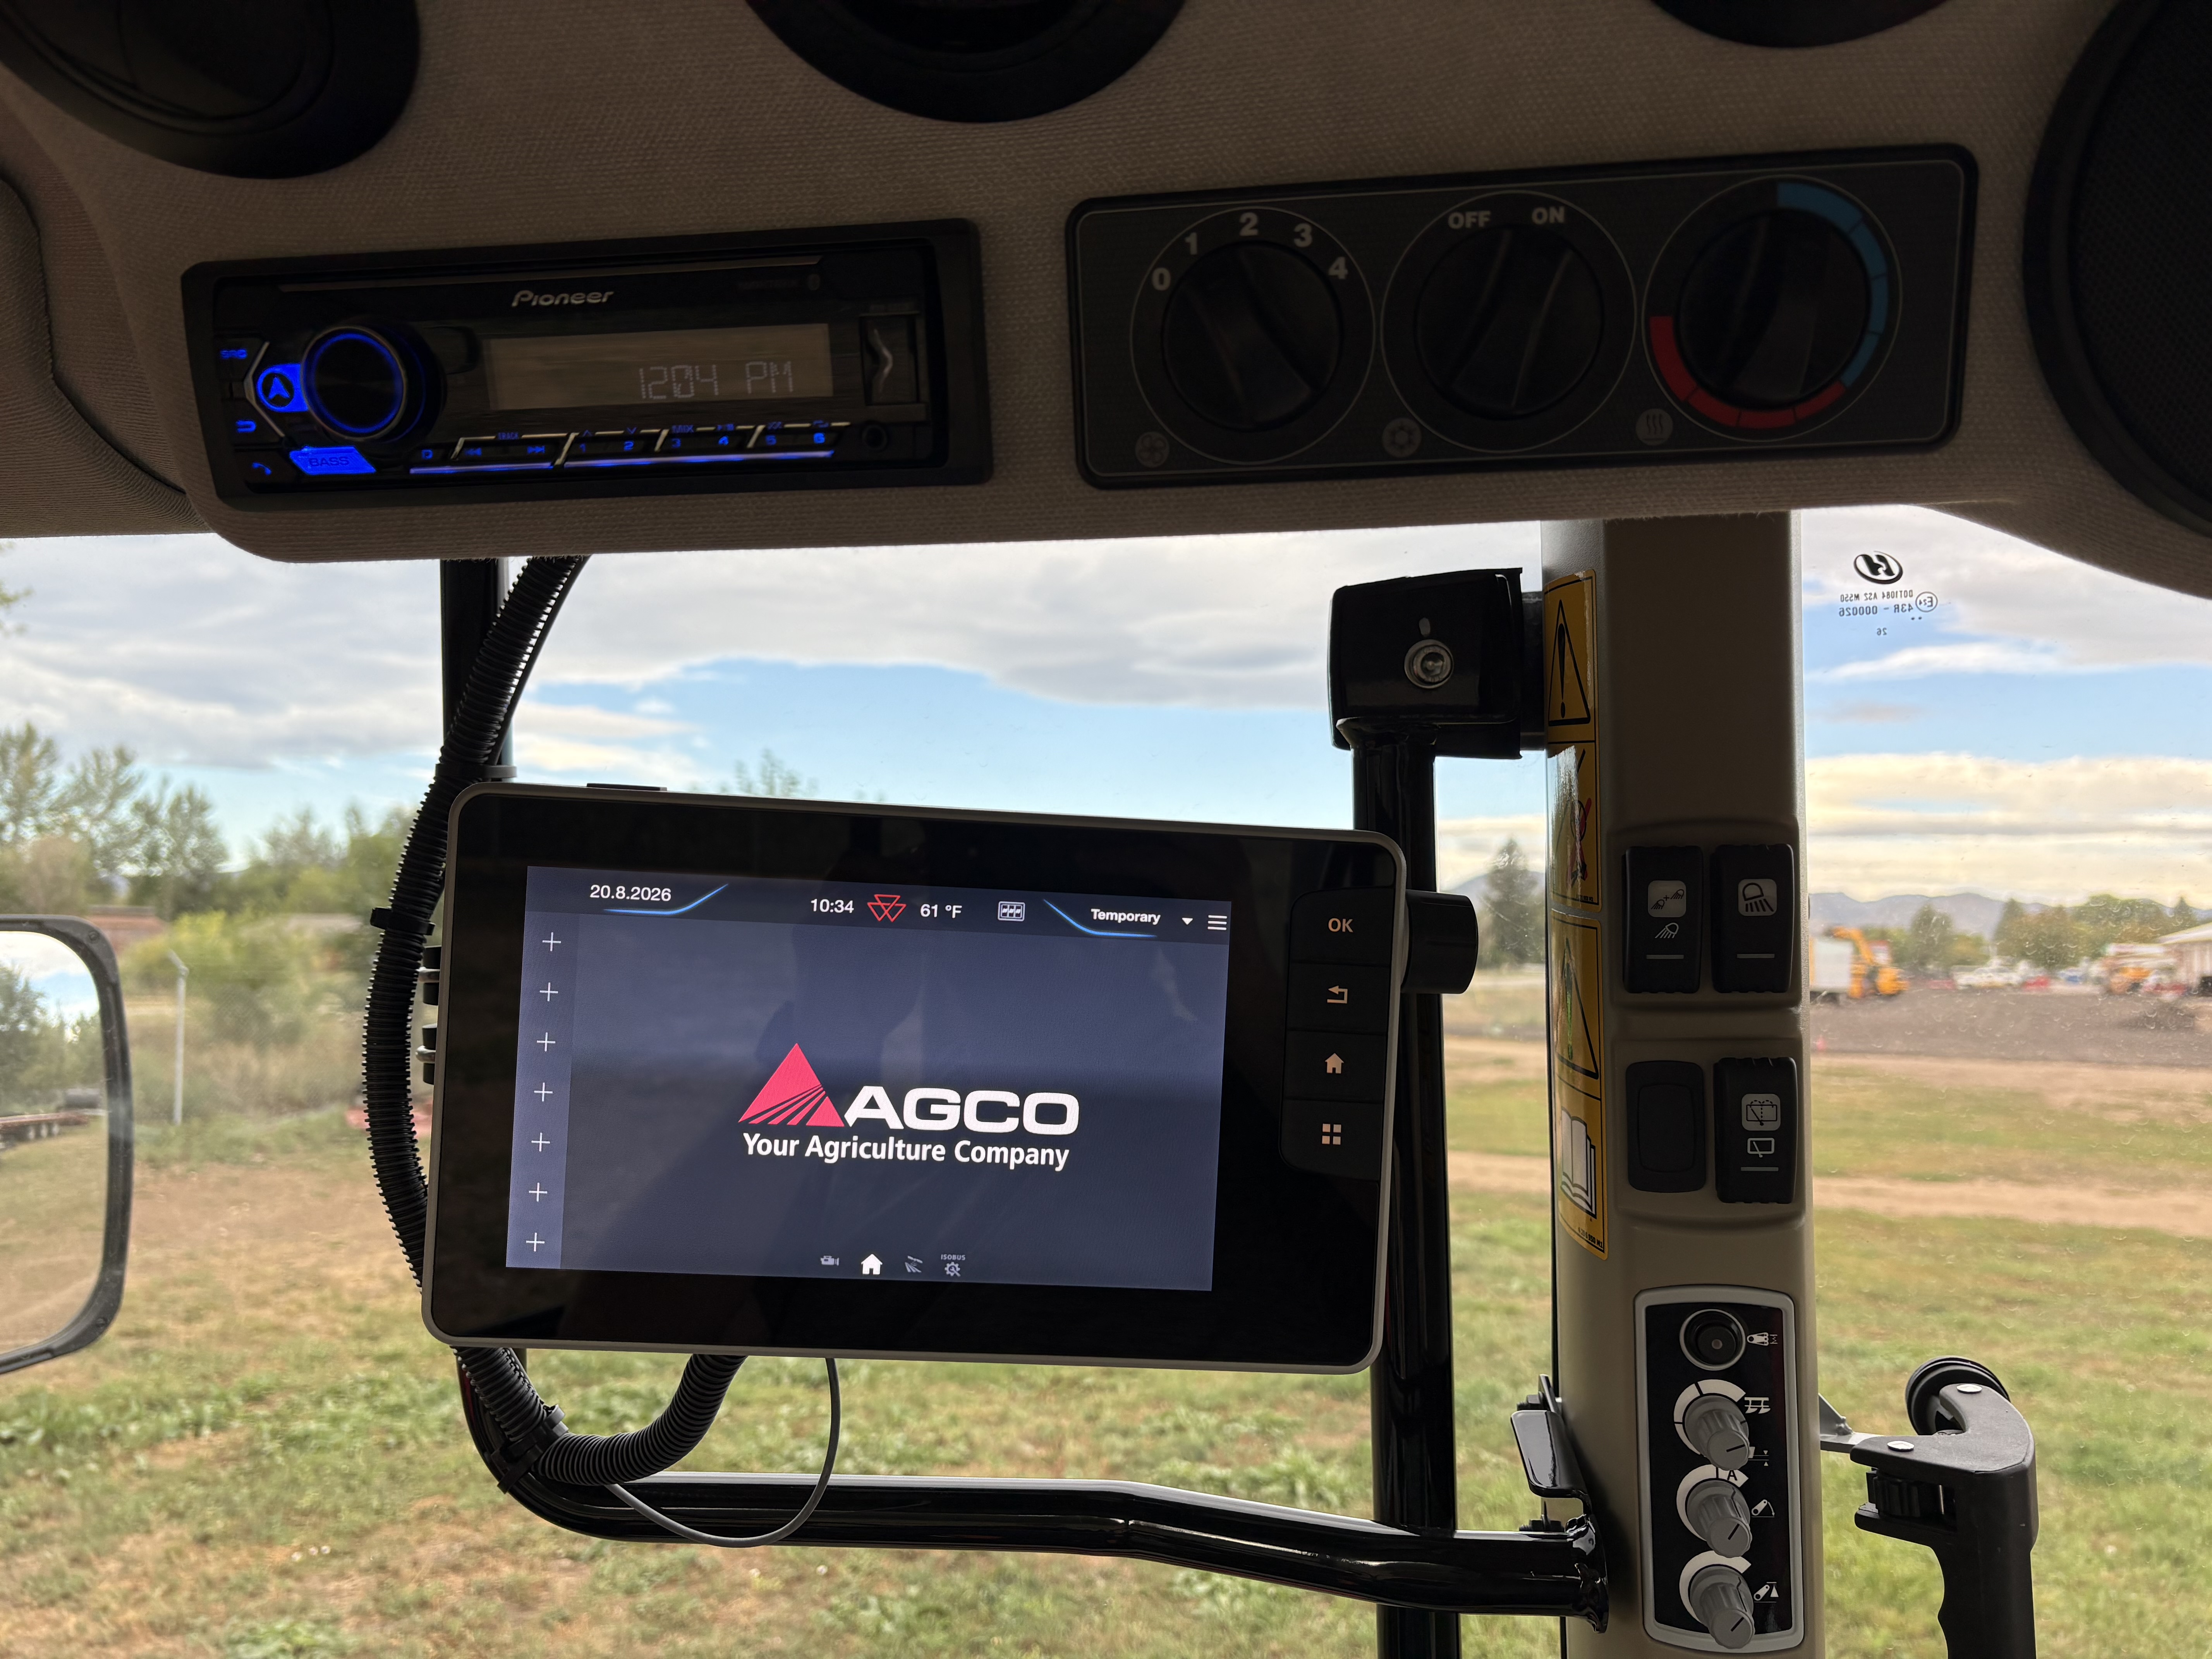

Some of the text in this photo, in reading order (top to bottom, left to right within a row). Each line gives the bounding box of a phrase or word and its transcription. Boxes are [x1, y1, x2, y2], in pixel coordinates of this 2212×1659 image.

[1448, 206, 1566, 230] OFF ON
[1152, 212, 1348, 291] 0 1 2 3 4
[512, 289, 614, 308] Pioneer
[745, 360, 793, 395] PM
[672, 425, 695, 433] MIX
[623, 441, 634, 451] 2
[310, 457, 349, 466] BASS
[590, 884, 672, 902] 20.8.2026
[811, 898, 854, 914] 10:34
[920, 904, 962, 919] 61 °F
[1091, 908, 1161, 925] Temporary
[1328, 917, 1354, 933] OK
[844, 1085, 1079, 1135] AGCO
[743, 1133, 1070, 1171] Your Agriculture Company
[1727, 1470, 1738, 1480] A
